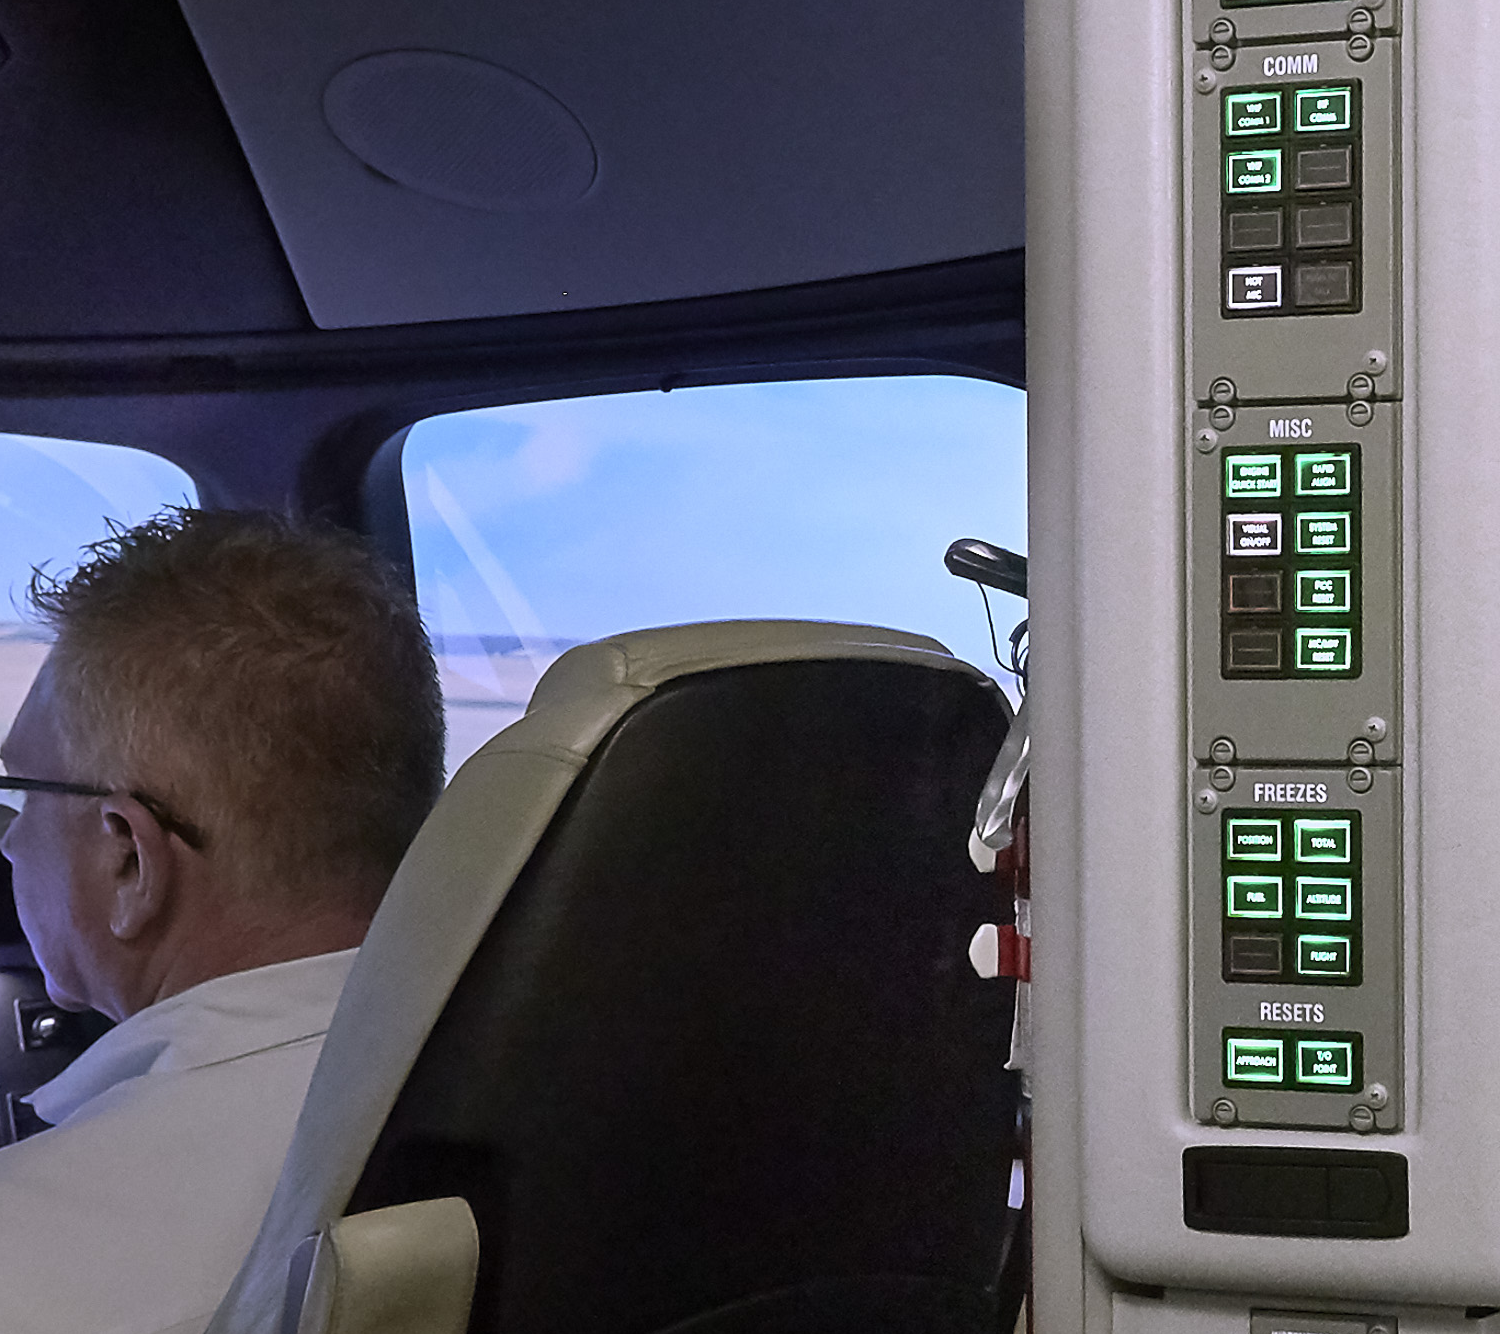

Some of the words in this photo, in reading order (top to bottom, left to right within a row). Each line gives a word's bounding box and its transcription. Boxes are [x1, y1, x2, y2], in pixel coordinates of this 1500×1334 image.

[1263, 54, 1318, 77] COMM
[1269, 419, 1312, 439] MISC
[1254, 783, 1328, 803] FREEZES
[1260, 1002, 1324, 1023] RESETS
